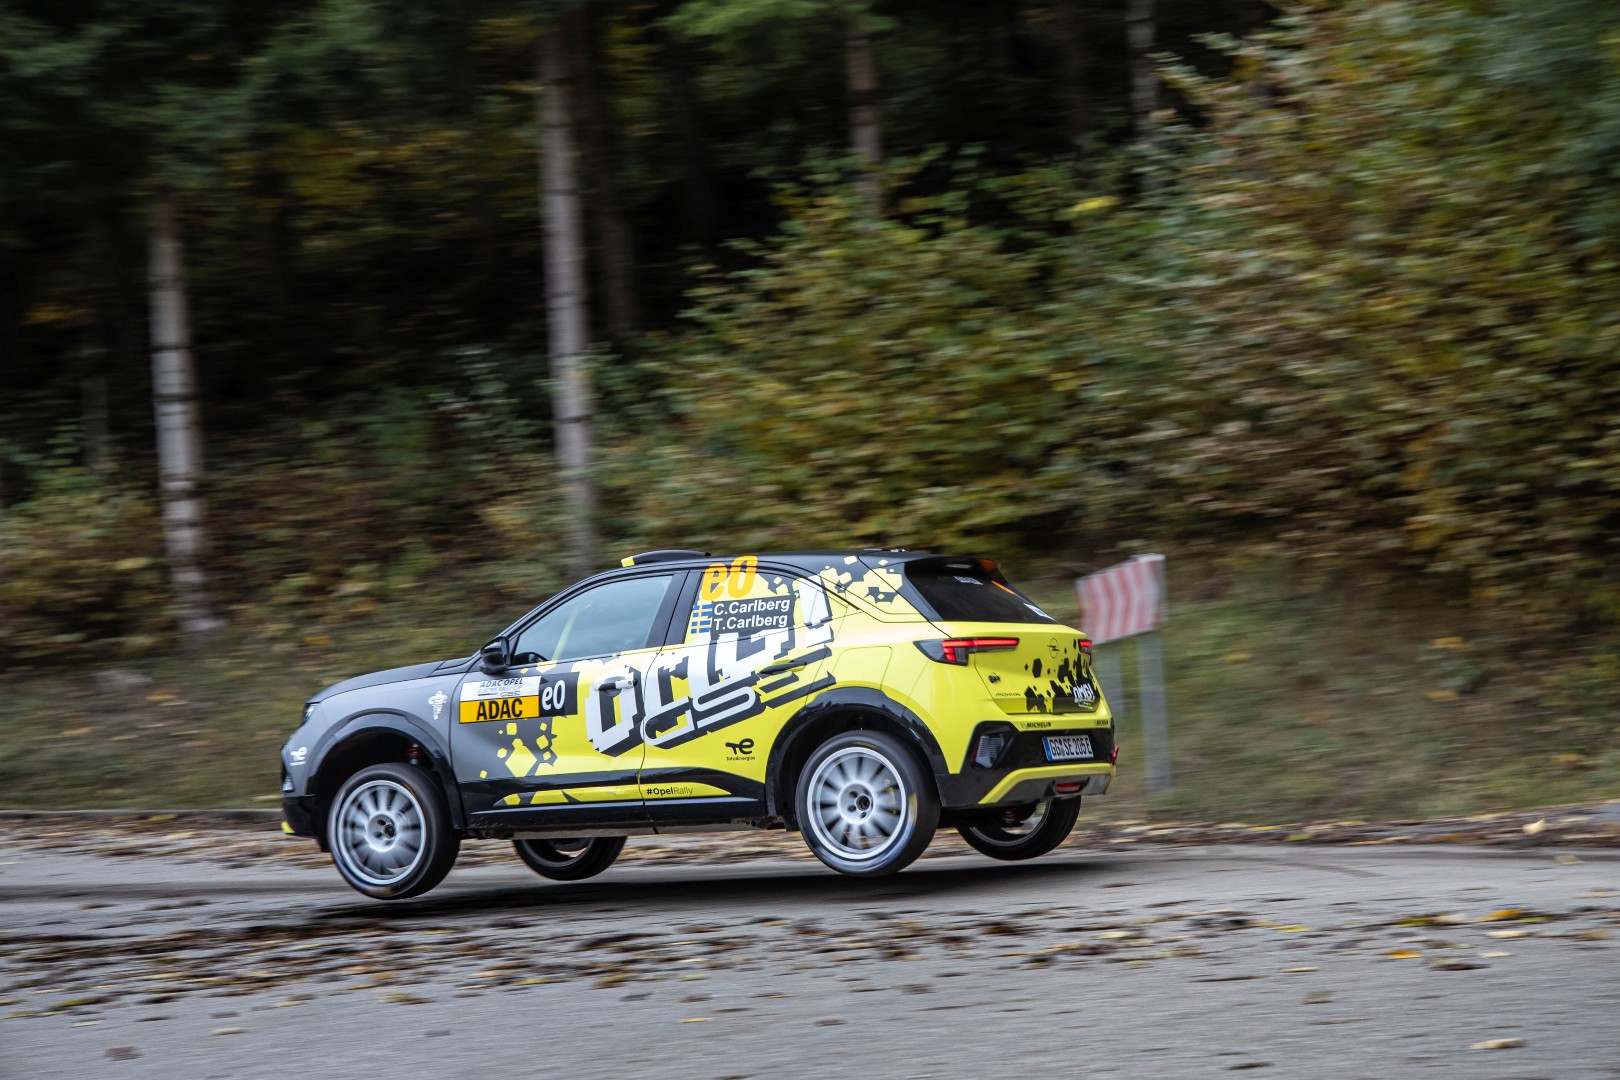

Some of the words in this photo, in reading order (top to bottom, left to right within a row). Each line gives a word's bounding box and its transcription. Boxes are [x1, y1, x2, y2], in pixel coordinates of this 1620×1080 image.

[713, 600, 790, 615] C.Carlberg
[713, 614, 788, 631] T.Carlberg
[479, 680, 503, 688] ADAC
[503, 677, 523, 686] OPEL
[476, 698, 523, 721] ADAC
[646, 786, 694, 797] #OpelRally
